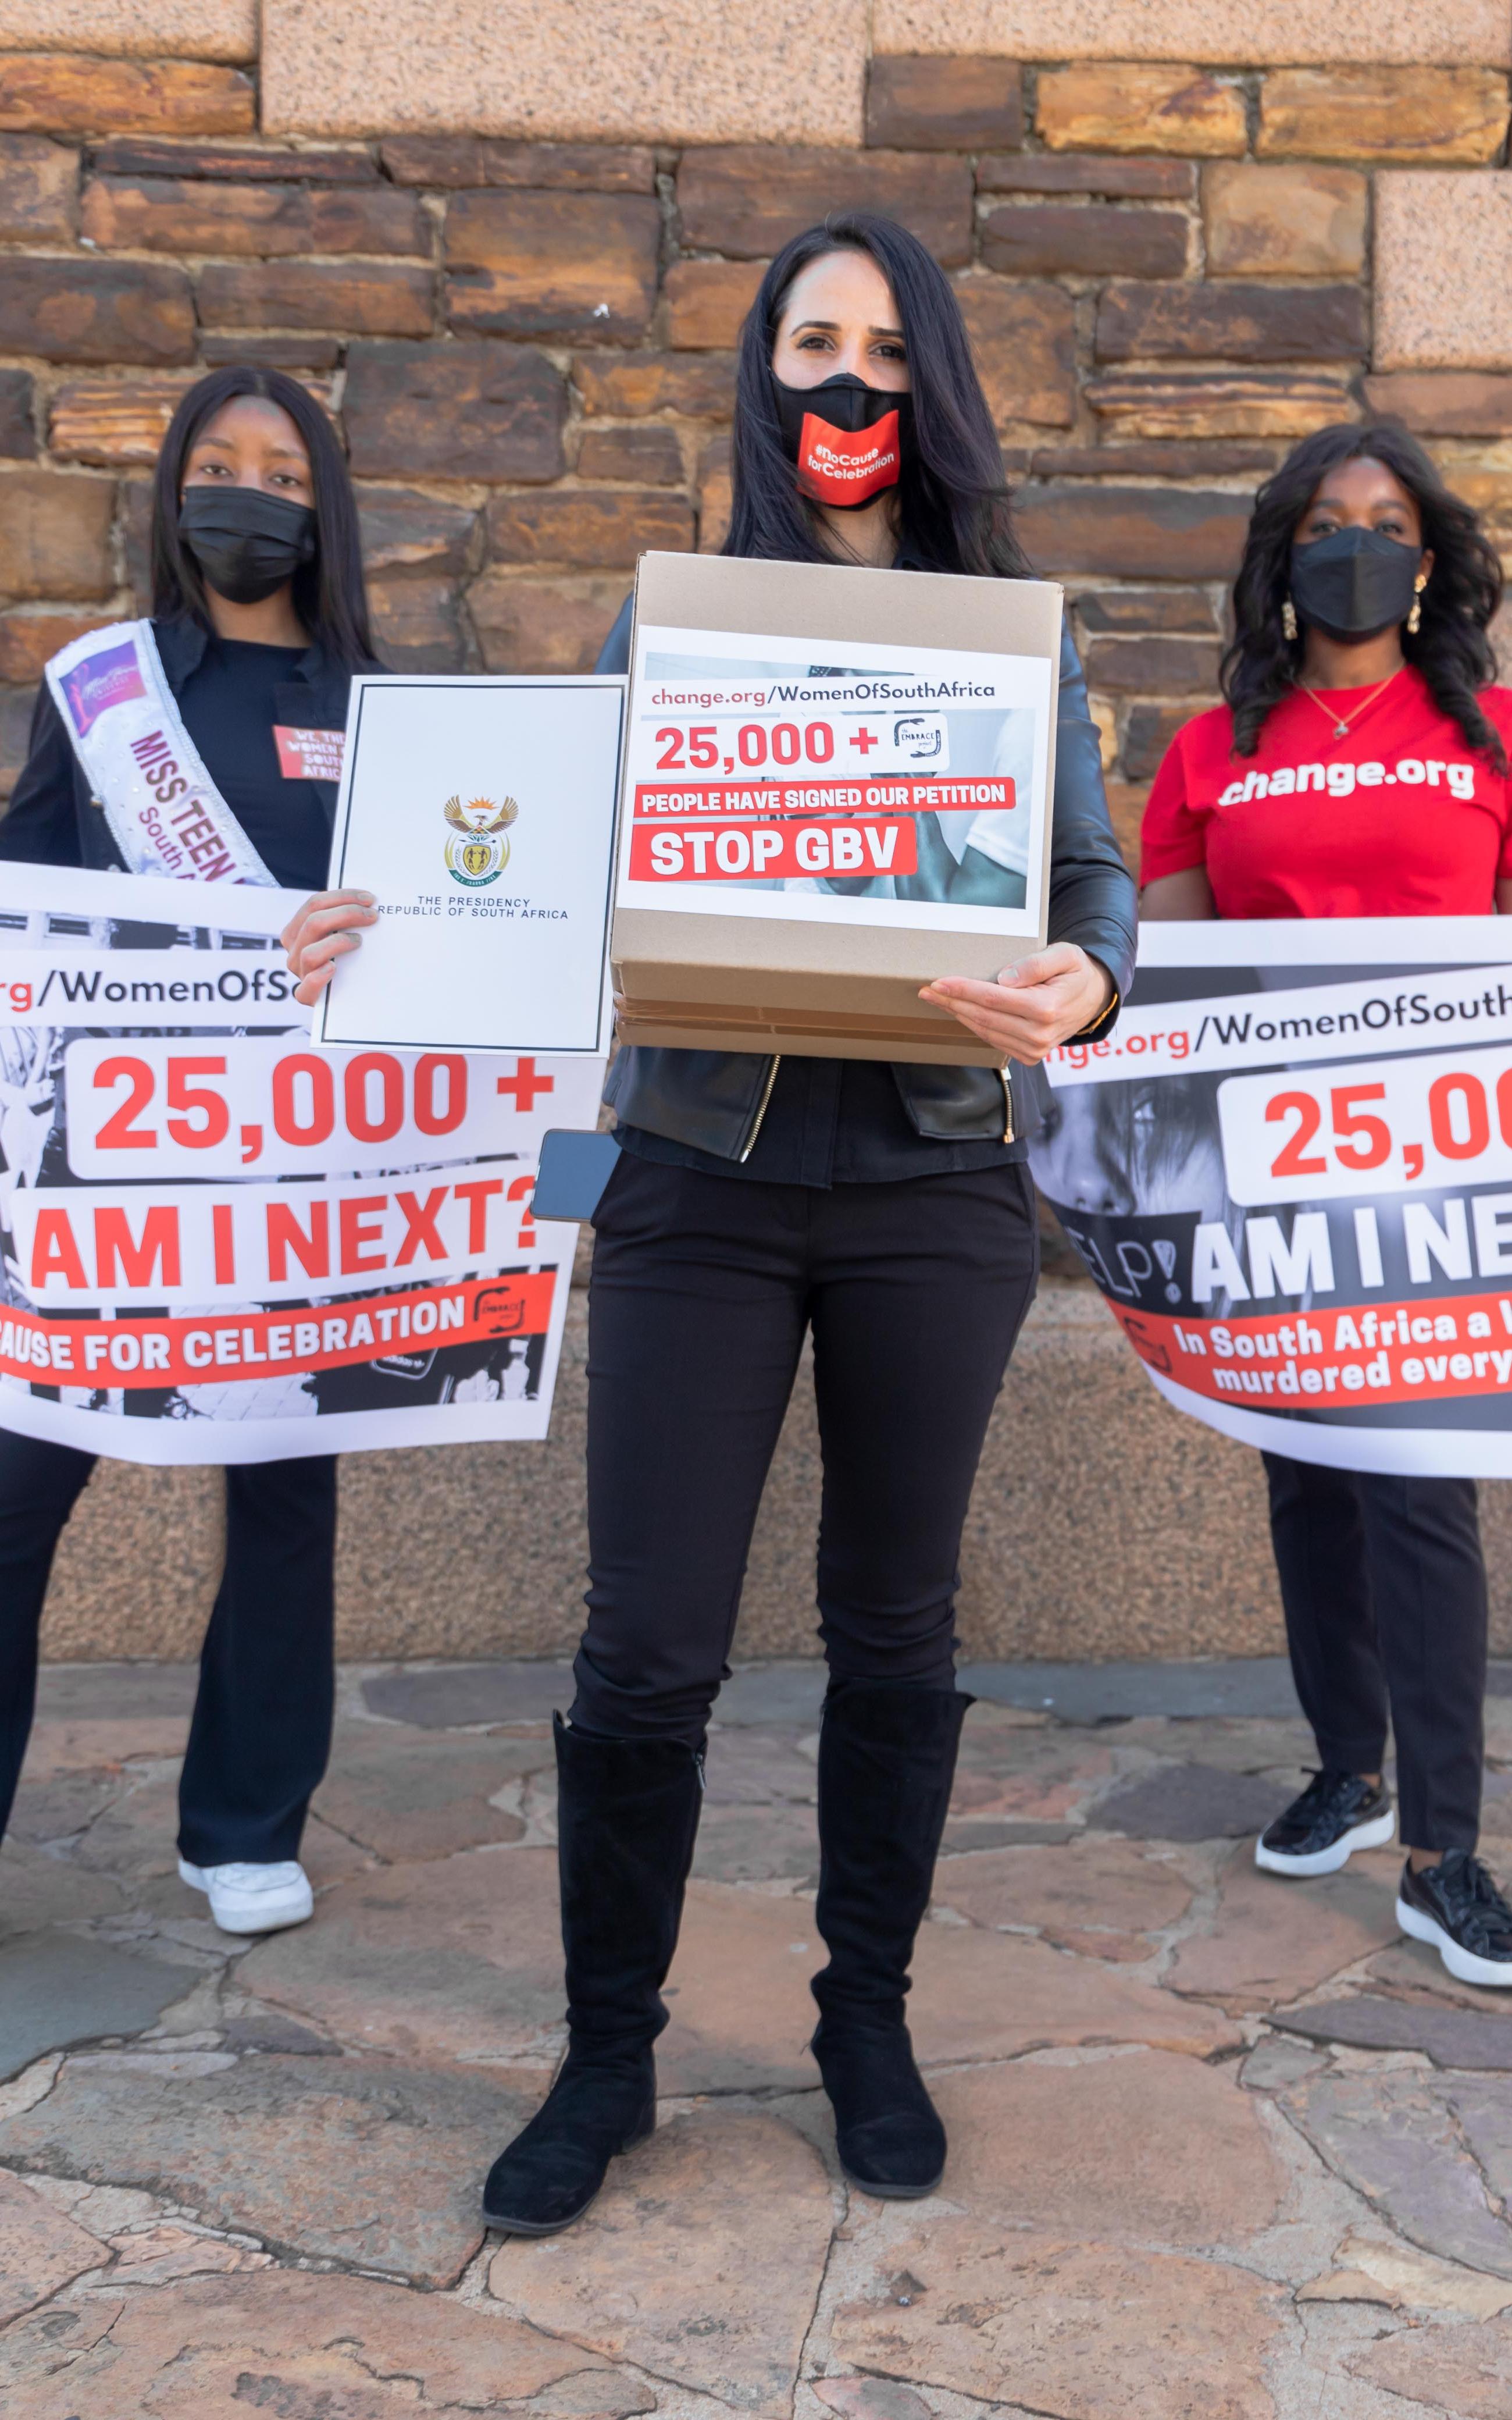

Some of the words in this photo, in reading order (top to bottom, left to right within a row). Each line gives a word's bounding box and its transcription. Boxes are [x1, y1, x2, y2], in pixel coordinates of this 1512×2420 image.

[808, 453, 894, 479] forCelebration
[651, 681, 995, 708] change.org/WomenOfSouthAfrica
[655, 722, 834, 774] 25,000
[850, 727, 878, 755] +
[901, 732, 935, 741] EMBRACE
[130, 730, 188, 803] MISS
[170, 799, 237, 882] TEEN
[643, 792, 721, 813] PEOPLE
[725, 789, 780, 810] HAVE
[785, 787, 862, 808] SIGNED
[866, 785, 908, 806] OUR
[913, 784, 1006, 804] PETITION
[1218, 759, 1475, 806] change.org
[138, 806, 184, 870] South
[650, 831, 784, 875] STOP
[795, 825, 900, 871] GBV
[378, 905, 441, 916] REPUBLIC
[448, 907, 465, 916] OF
[472, 908, 514, 917] SOUTH
[520, 909, 568, 919] AFRICA
[418, 896, 442, 905] THE
[449, 897, 530, 908] PRESIDENCY
[92, 1052, 467, 1163] 25,000
[497, 1057, 554, 1112] +
[1265, 1066, 1512, 1181] 25,0
[30, 1206, 181, 1289] AM
[213, 1205, 236, 1285] I
[266, 1175, 536, 1282] NEXT?
[1192, 1211, 1334, 1302] AM
[1353, 1207, 1383, 1288] I
[0, 1318, 74, 1370] AUSE
[84, 1333, 170, 1371] FOR
[183, 1295, 464, 1368] CELEBRATION
[1173, 1323, 1207, 1355] In
[1210, 1319, 1323, 1358] South
[1335, 1309, 1457, 1352] Africa
[1468, 1312, 1492, 1339] a
[1213, 1350, 1391, 1394] murdered
[1401, 1349, 1512, 1384] every
